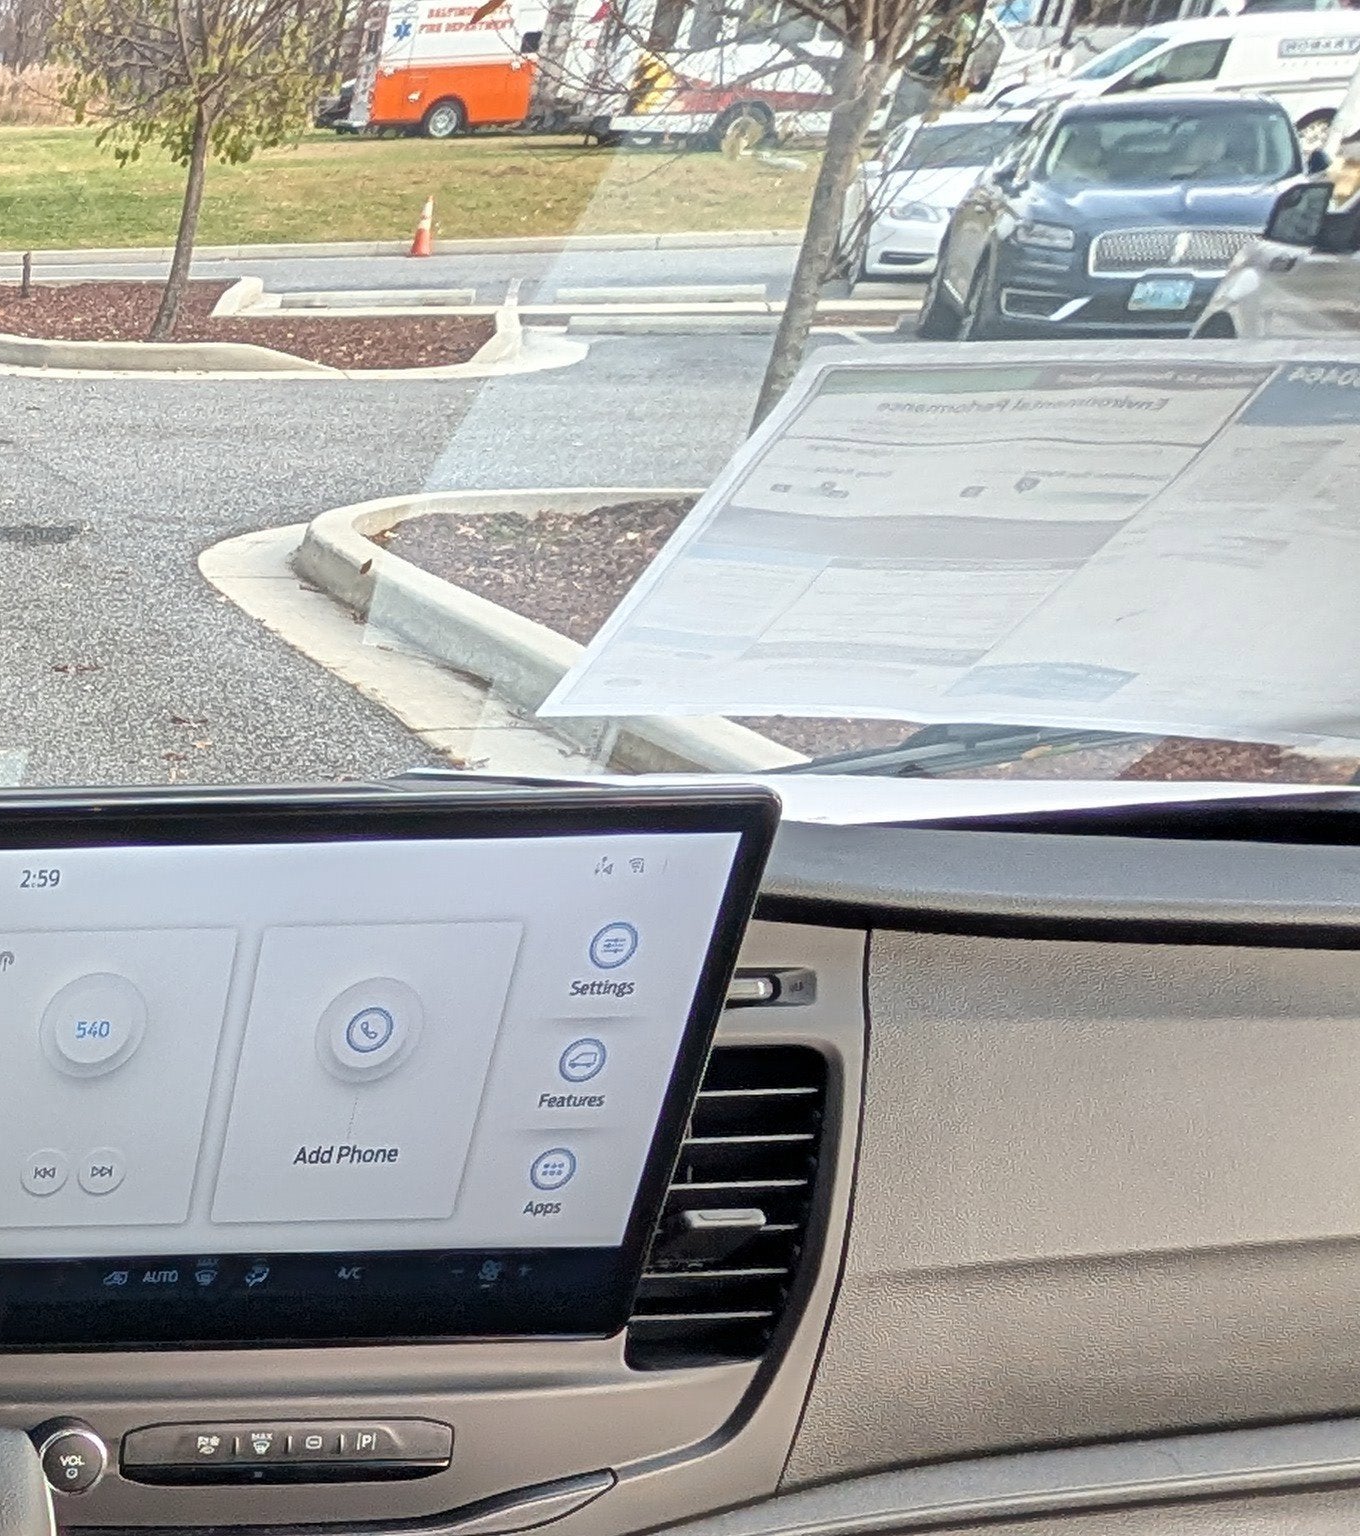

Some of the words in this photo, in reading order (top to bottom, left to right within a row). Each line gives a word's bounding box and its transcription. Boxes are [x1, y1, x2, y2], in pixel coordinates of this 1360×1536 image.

[19, 868, 61, 890] 2:59
[569, 977, 636, 999] Settings
[74, 1019, 112, 1041] 540
[537, 1091, 607, 1111] Features
[293, 1145, 333, 1167] Add
[338, 1143, 400, 1166] Phone
[522, 1199, 562, 1218] Apps
[142, 1269, 179, 1284] AUTO
[60, 1455, 86, 1468] VOL
